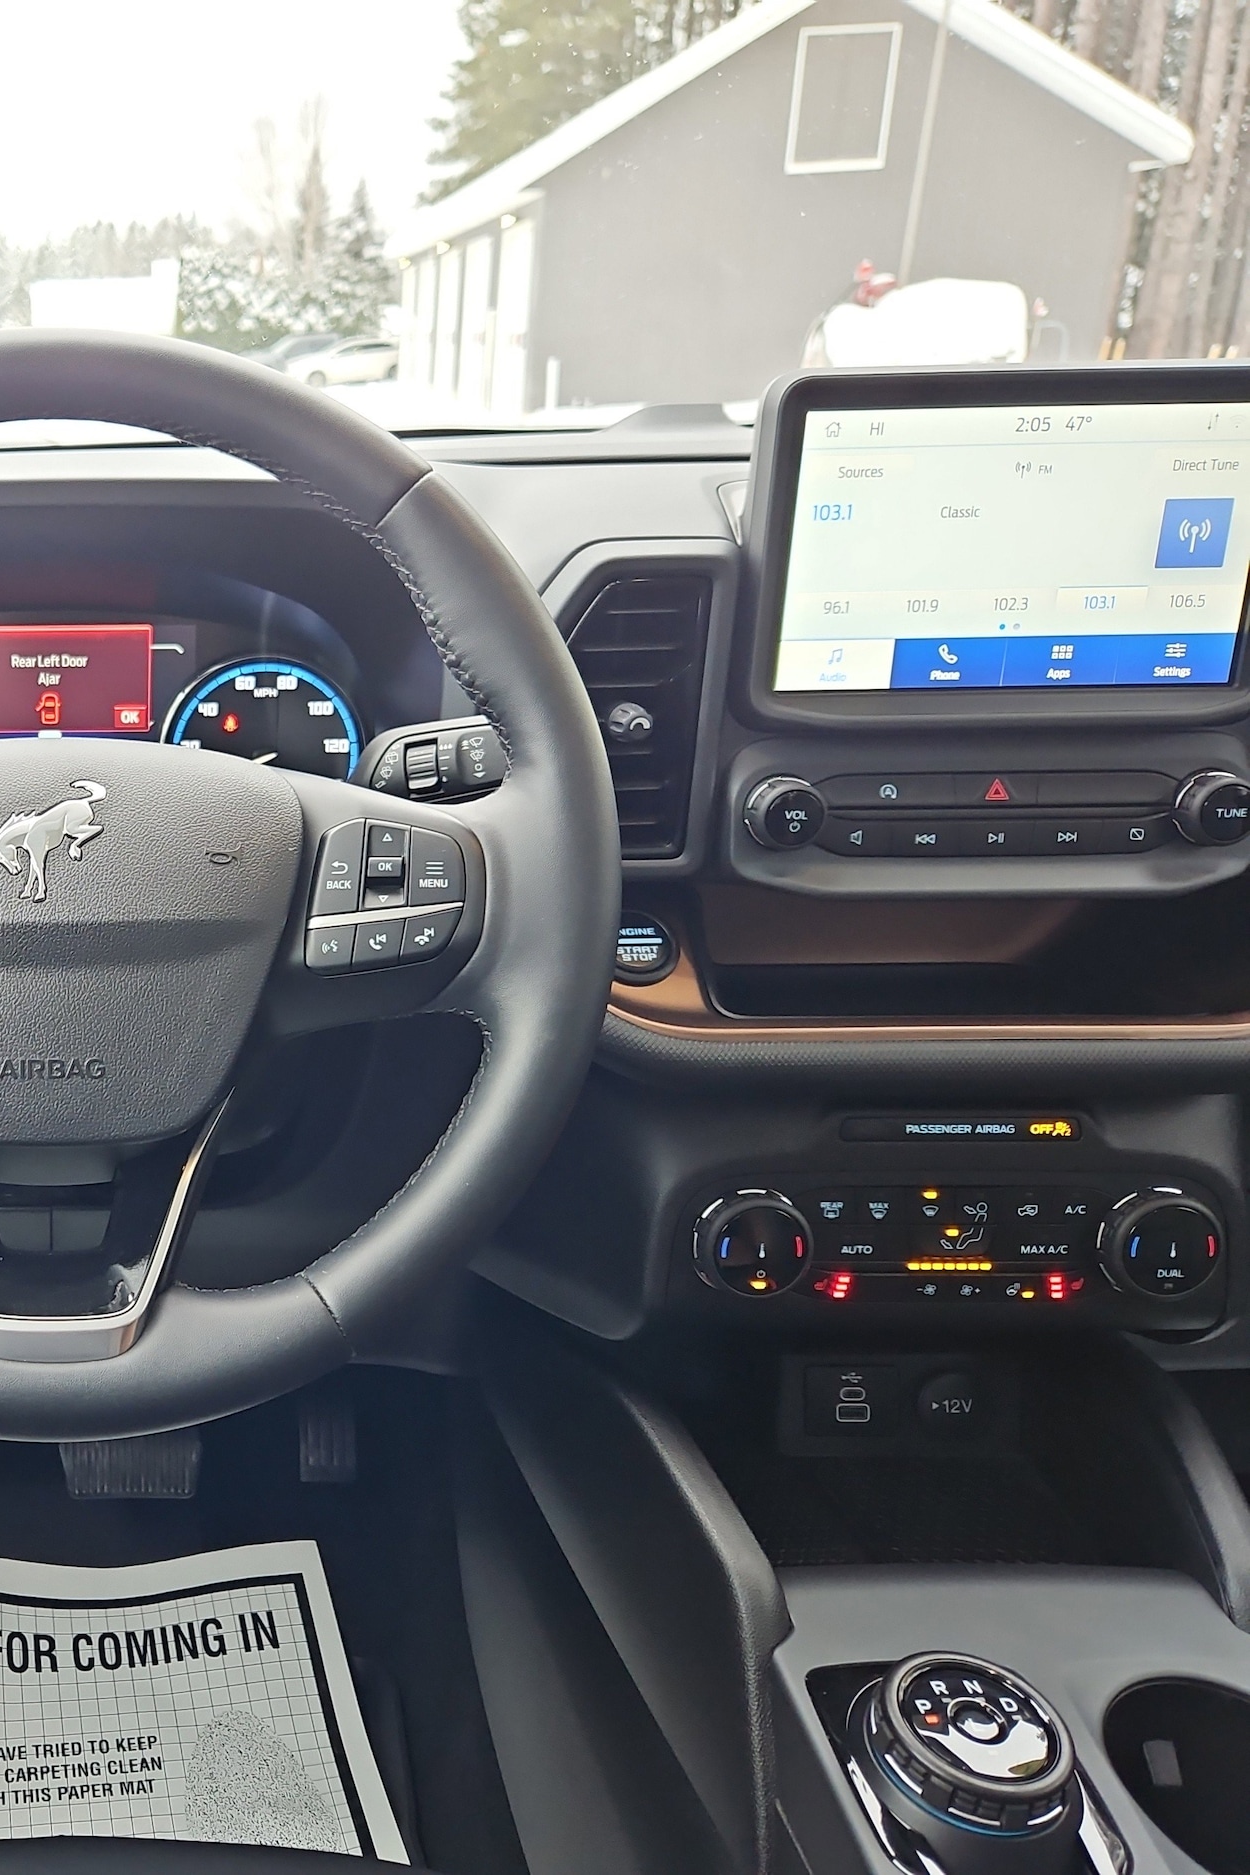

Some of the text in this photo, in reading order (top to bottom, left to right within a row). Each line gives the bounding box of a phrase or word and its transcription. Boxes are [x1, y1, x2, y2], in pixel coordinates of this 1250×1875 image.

[869, 422, 885, 436] HI
[1015, 415, 1093, 433] 2:05 47°
[838, 465, 884, 479] Sources
[1038, 463, 1053, 475] FM
[1173, 458, 1239, 473] Direct Tune
[812, 504, 853, 521] 103.1
[940, 505, 981, 519] Classic
[823, 600, 850, 615] 96.1
[906, 598, 939, 613] 101.9
[993, 597, 1029, 612] 102.3
[1083, 595, 1116, 610] 103.1
[1169, 594, 1207, 609] 106.5
[11, 654, 88, 668] Rear Left Door
[37, 672, 61, 686] Ajar
[819, 671, 847, 683] Audio
[929, 669, 961, 681] Phone
[1046, 668, 1071, 681] Apps
[1153, 665, 1192, 679] Settings
[235, 675, 256, 691] 60
[277, 675, 298, 691] 80
[253, 688, 279, 698] MPH
[198, 702, 219, 717] 40
[307, 700, 334, 716] 100
[120, 710, 140, 724] OK
[323, 738, 350, 754] 120
[785, 810, 808, 821] VOL
[1216, 807, 1248, 818] TUNE
[378, 862, 392, 872] OK
[326, 880, 351, 890] BACK
[419, 879, 449, 888] MENU
[618, 927, 656, 936] NGINE
[616, 946, 659, 955] START
[621, 953, 657, 962] STOP
[905, 1124, 972, 1135] PASSENGER
[975, 1124, 1016, 1135] AIRBAG
[1030, 1123, 1054, 1135] OFF
[819, 1202, 843, 1210] REAR
[868, 1202, 890, 1210] MAX
[1065, 1205, 1087, 1215] A/C
[840, 1245, 873, 1255] AUTO
[1020, 1244, 1069, 1255] MAX A/C
[1156, 1268, 1185, 1278] DUAL
[942, 1398, 973, 1413] 12V
[72, 1617, 227, 1671] COMING
[238, 1609, 280, 1652] IN
[930, 1680, 948, 1695] R
[962, 1680, 983, 1694] N
[914, 1699, 932, 1714] P
[999, 1698, 1018, 1712] D
[32, 1741, 82, 1759] TRIED
[88, 1739, 110, 1755] TO
[116, 1735, 158, 1753] KEEP
[5, 1761, 102, 1784] CARPETING
[107, 1756, 163, 1776] CLEAN
[12, 1787, 51, 1805] THIS
[58, 1783, 114, 1801] PAPER
[119, 1778, 156, 1796] MAT
